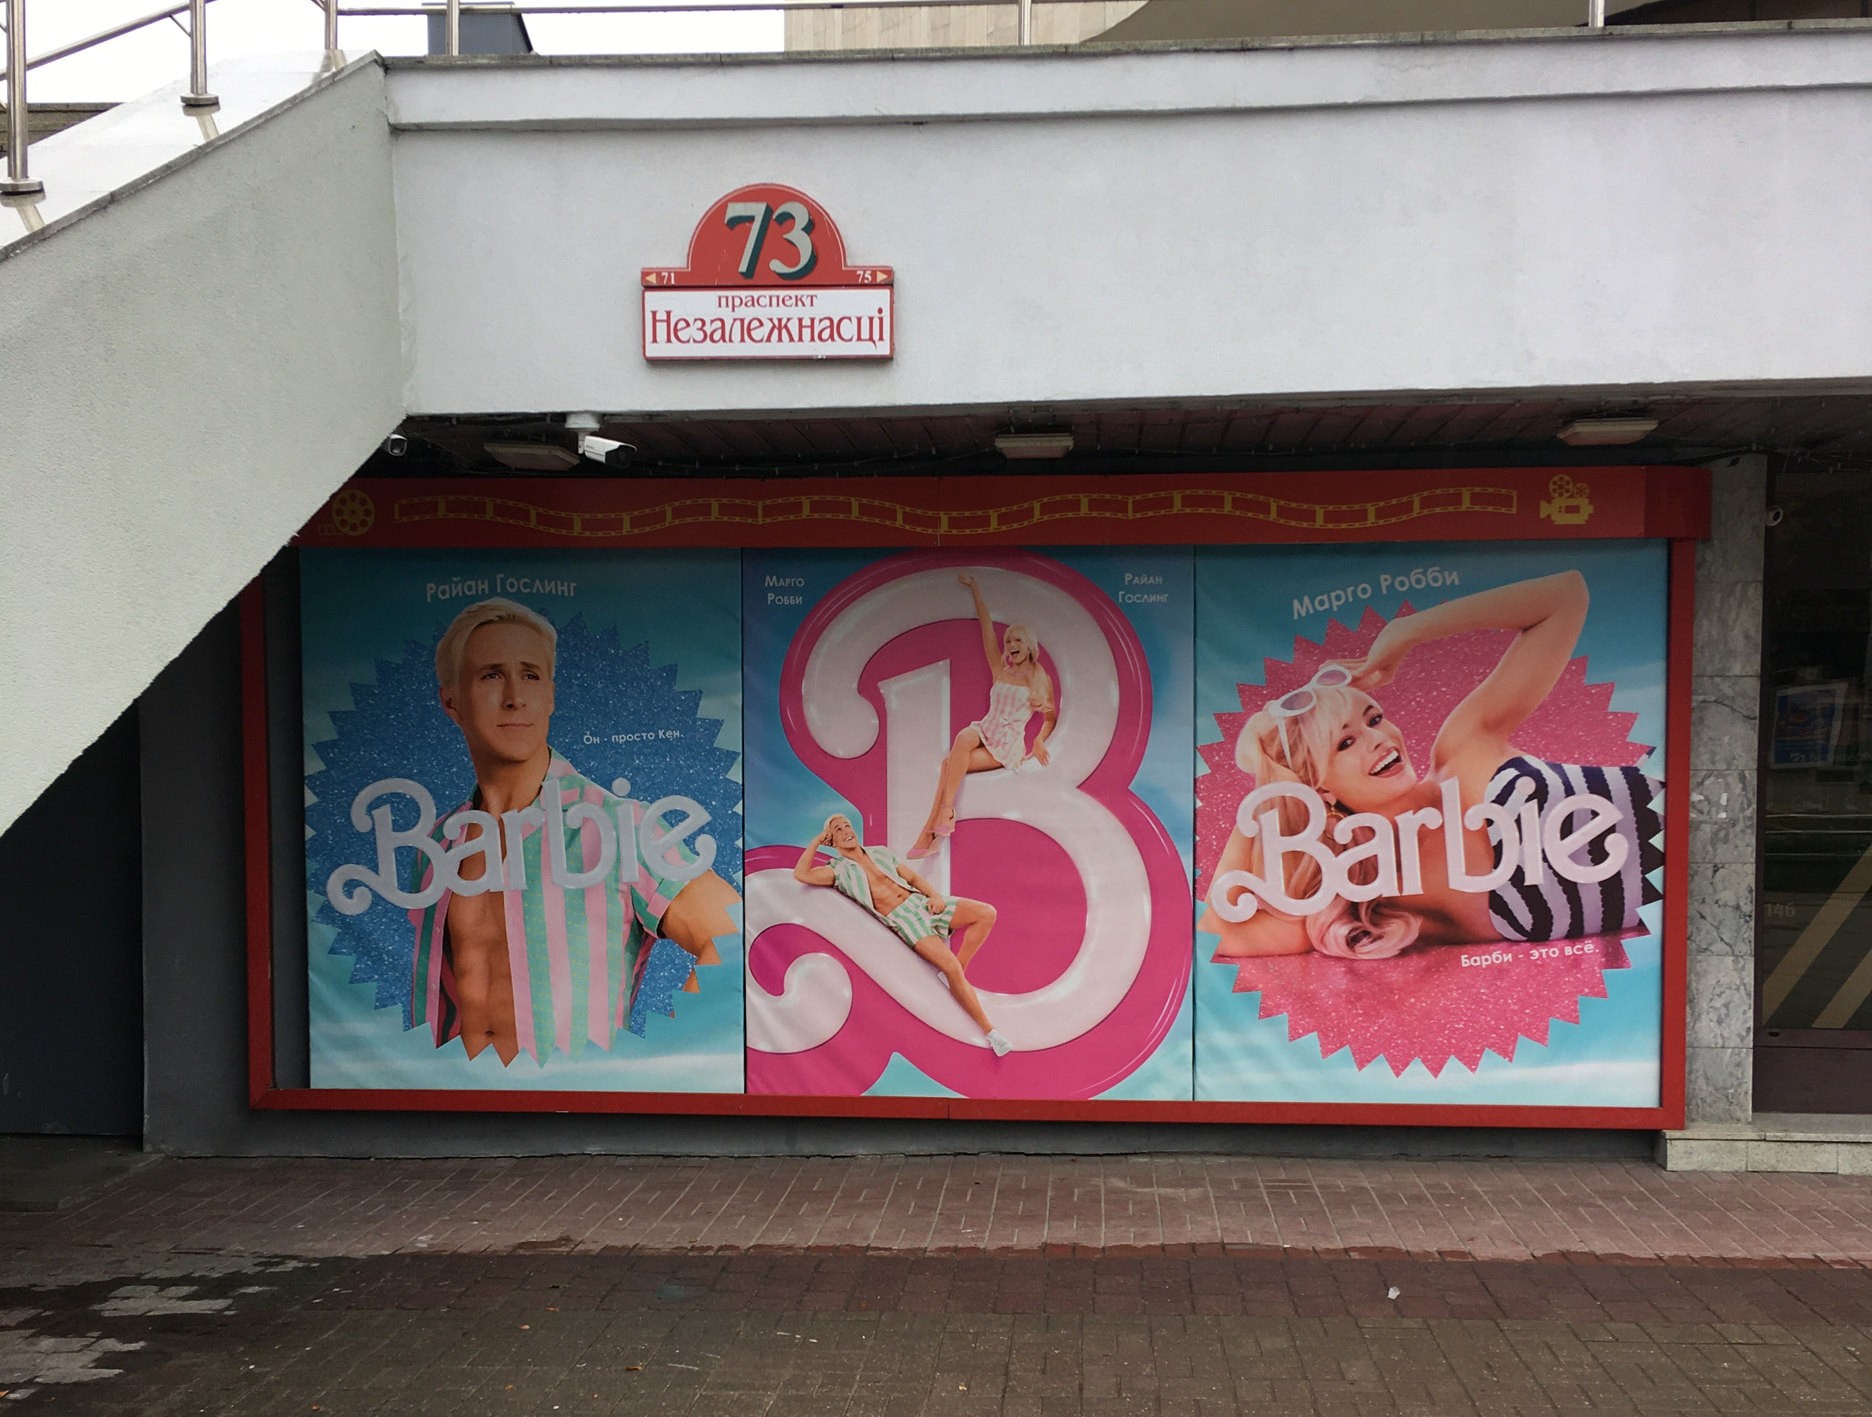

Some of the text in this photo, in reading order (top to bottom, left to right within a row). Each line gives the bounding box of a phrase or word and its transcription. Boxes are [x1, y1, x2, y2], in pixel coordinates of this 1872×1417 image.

[724, 201, 817, 280] 73
[661, 273, 676, 285] 71
[856, 271, 872, 283] 75
[717, 294, 818, 312] праспект
[650, 306, 886, 349] Незалежнасці
[426, 573, 577, 602] Райан Гослинг
[1292, 566, 1460, 620] Марго Робби
[583, 734, 600, 745] Он
[611, 731, 655, 744] просто
[327, 777, 718, 915] Barbie
[1210, 776, 1629, 923] Barbie
[1460, 950, 1513, 968] Барби
[1529, 947, 1560, 960] это
[1564, 940, 1600, 955] всё.
